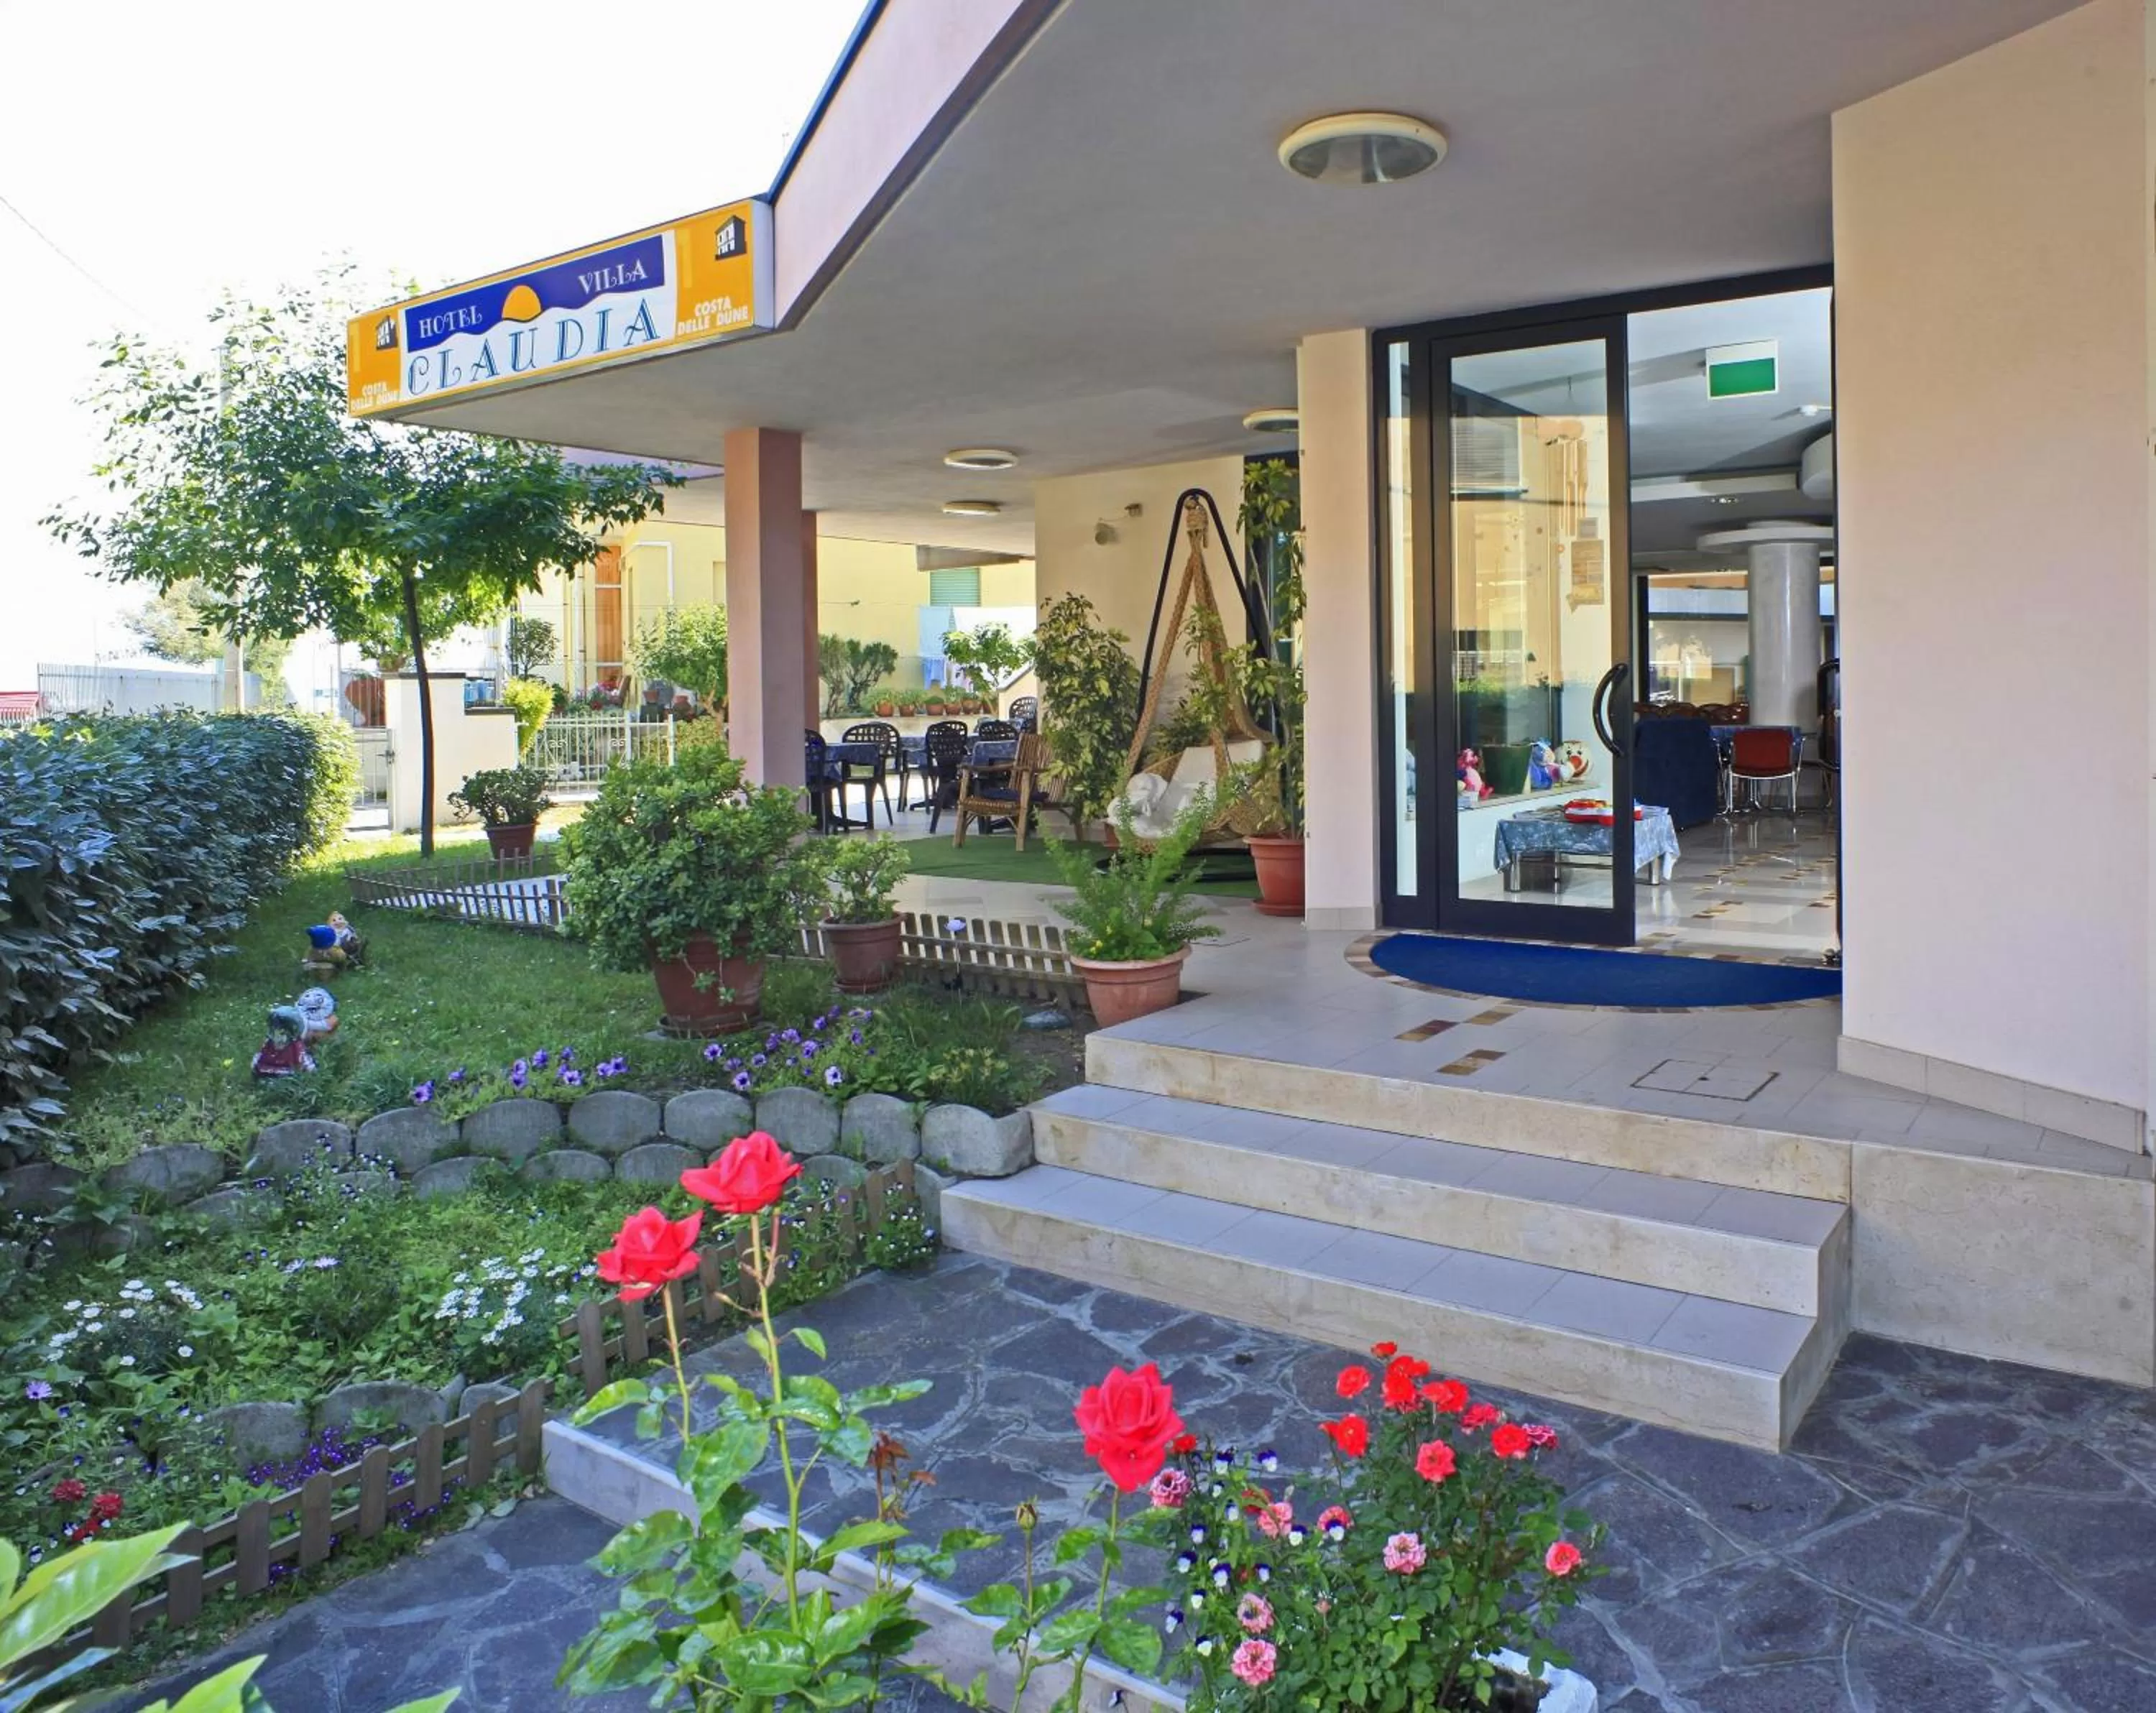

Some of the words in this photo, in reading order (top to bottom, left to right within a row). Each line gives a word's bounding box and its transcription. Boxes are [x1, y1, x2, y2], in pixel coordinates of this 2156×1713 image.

[418, 305, 483, 339] HOTEL
[578, 259, 648, 295] VILLA
[677, 315, 711, 336] DELLE
[716, 305, 749, 326] DUNE
[694, 295, 732, 317] COSTA
[407, 297, 660, 396] CLAUDIA
